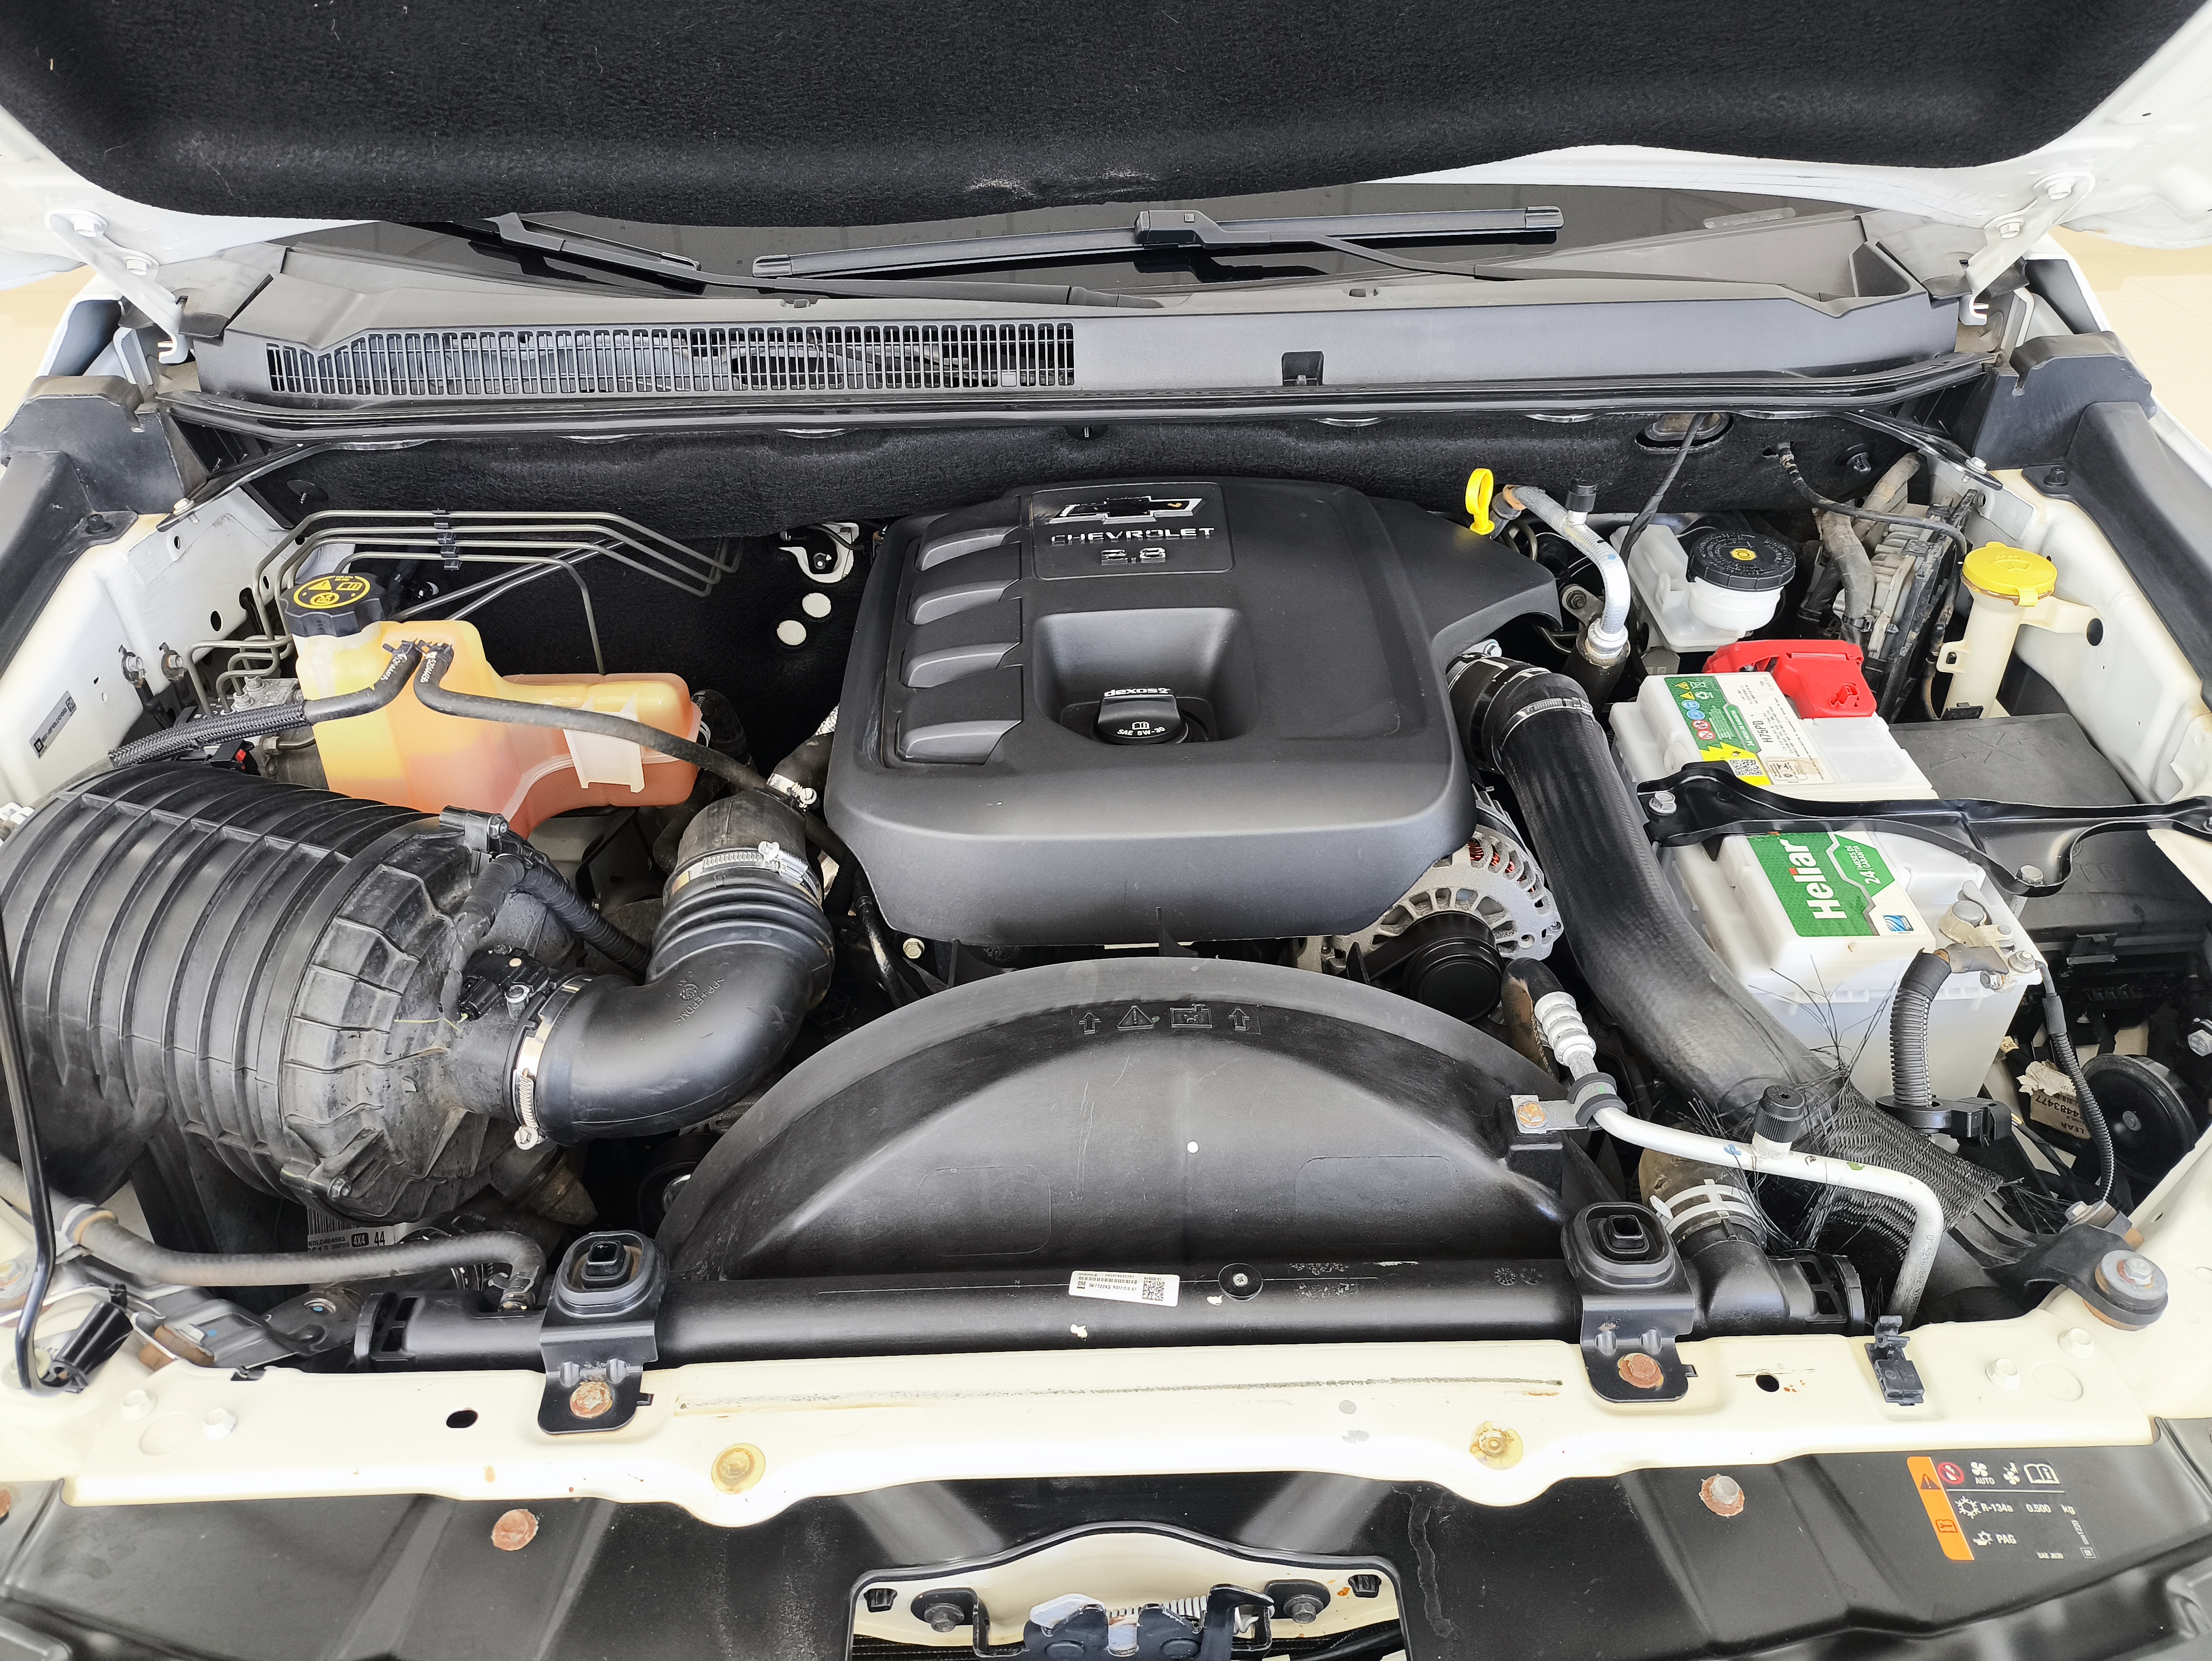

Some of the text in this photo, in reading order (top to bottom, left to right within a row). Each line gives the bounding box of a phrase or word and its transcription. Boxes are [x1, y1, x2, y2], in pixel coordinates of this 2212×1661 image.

[1051, 528, 1215, 545] CHEVROLET
[1101, 547, 1166, 565] 2.8
[1137, 726, 1165, 735] 5W-30
[1752, 720, 1774, 742] H75PD
[1848, 852, 1864, 868] MESES
[1779, 838, 1847, 919] Heliar
[1859, 870, 1881, 884] 24
[2035, 1095, 2082, 1120] 4483477
[2060, 1121, 2084, 1134] LEAR
[374, 1230, 385, 1246] 44
[1975, 1476, 1995, 1485] AUTO
[1980, 1503, 2076, 1515] R-134a 0.500 kg
[1995, 1533, 2017, 1544] PAG
